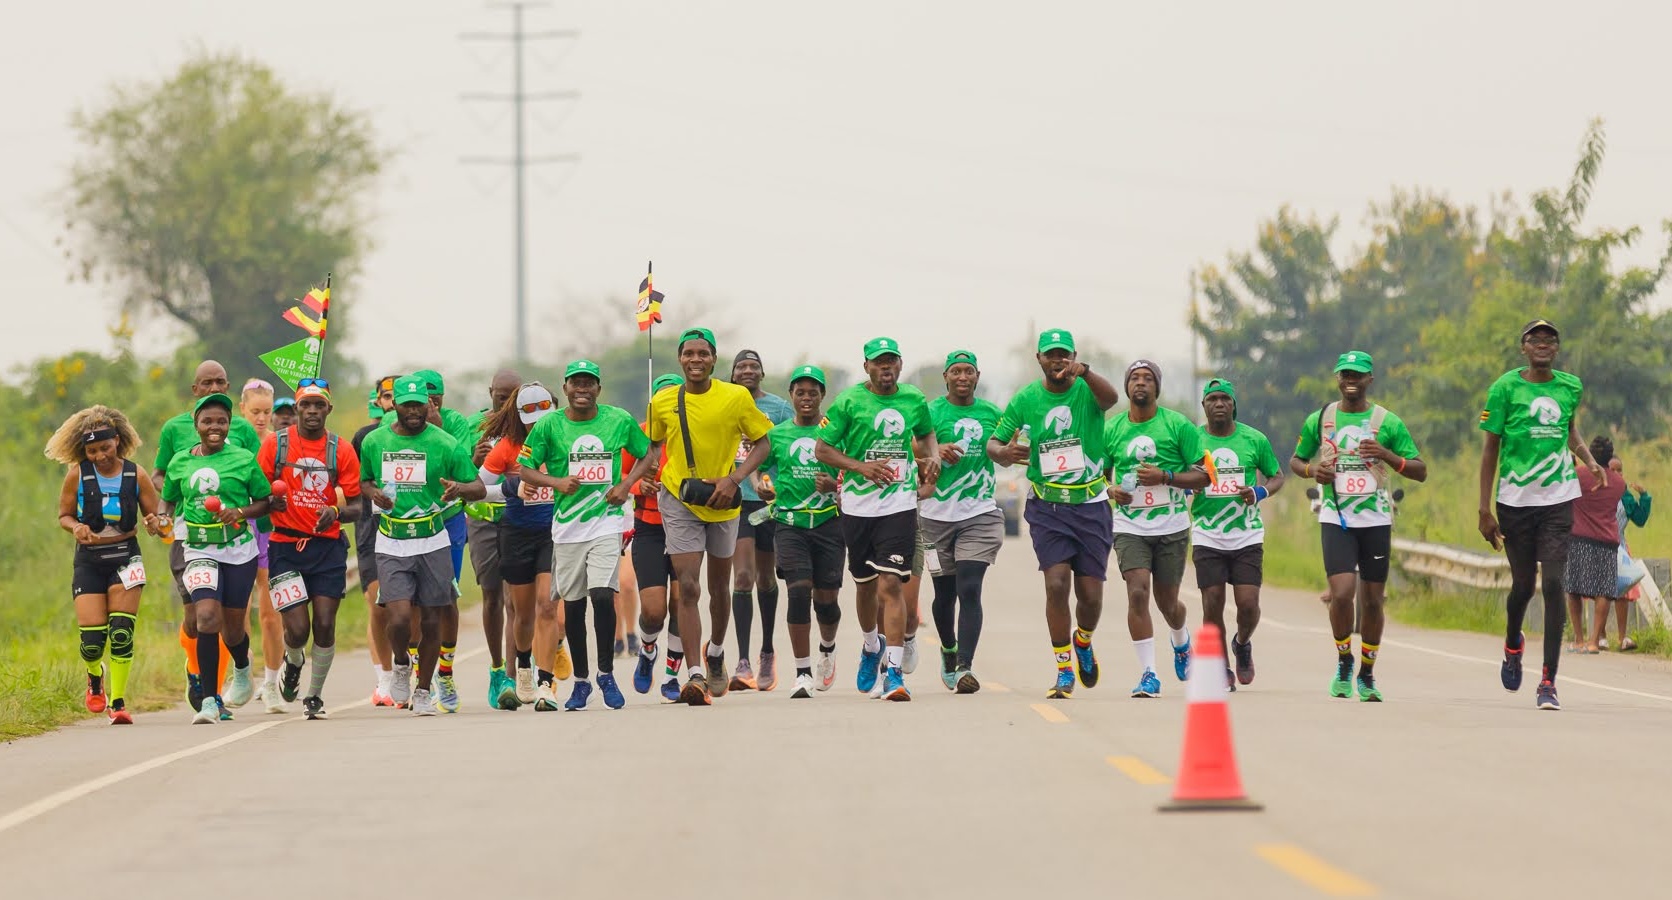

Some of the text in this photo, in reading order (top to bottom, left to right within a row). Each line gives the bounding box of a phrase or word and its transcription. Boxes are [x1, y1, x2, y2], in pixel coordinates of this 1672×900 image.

[273, 356, 297, 370] SUB
[1056, 455, 1067, 470] 2
[394, 466, 414, 481] 87
[576, 466, 606, 480] 460
[1211, 480, 1238, 494] 463
[1346, 477, 1367, 493] 89
[1144, 491, 1154, 506] 8
[187, 571, 211, 588] 353
[274, 584, 302, 606] 213
